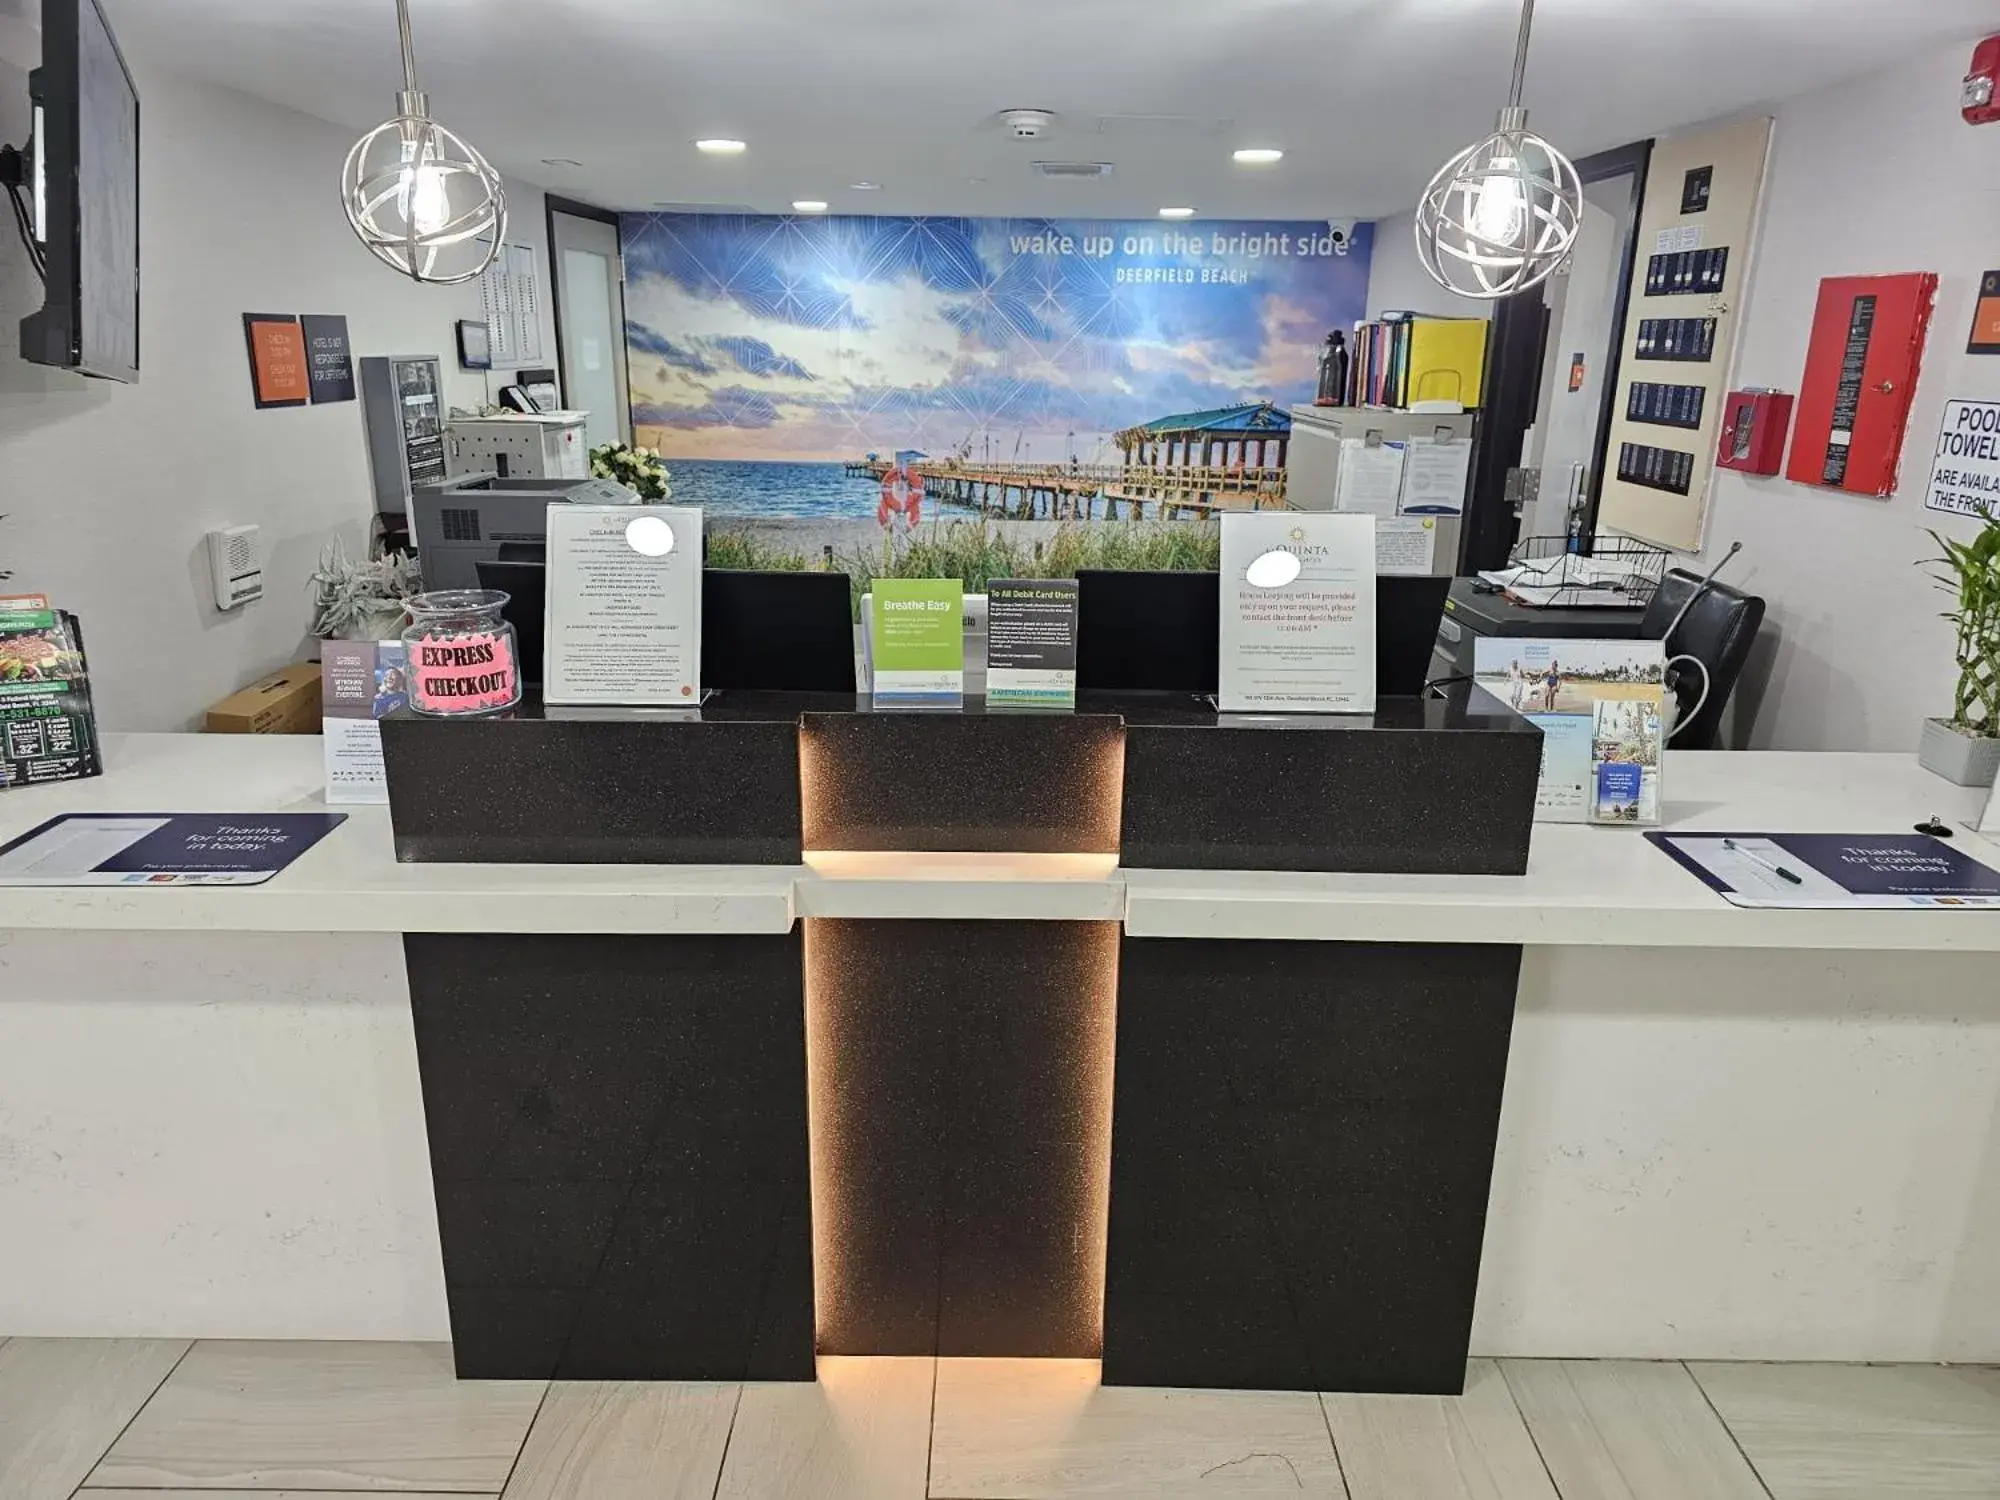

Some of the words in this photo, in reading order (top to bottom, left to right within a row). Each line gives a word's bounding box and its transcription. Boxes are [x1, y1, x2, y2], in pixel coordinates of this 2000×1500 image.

[1010, 231, 1074, 255] wake
[1083, 235, 1114, 258] up
[1123, 235, 1157, 255] on
[1163, 231, 1203, 255] the
[1212, 232, 1290, 258] bright
[1116, 268, 1194, 283] DEERFIELD
[1201, 268, 1249, 283] BEACH
[1934, 468, 1959, 487] ARE
[1934, 490, 1957, 508] THE
[990, 590, 1000, 598] To
[1001, 590, 1012, 598] All
[1012, 590, 1034, 598] Debit
[1036, 591, 1054, 599] Card
[1055, 591, 1076, 600] Users
[1322, 592, 1356, 602] provided
[883, 600, 926, 611] Breathe
[927, 600, 951, 612] Easy
[421, 643, 494, 667] EXPRESS
[425, 670, 507, 697] CHECKOUT
[216, 826, 281, 834] Thanks
[185, 834, 214, 842] for
[217, 834, 290, 843] coming
[1840, 847, 1917, 856] Thanks
